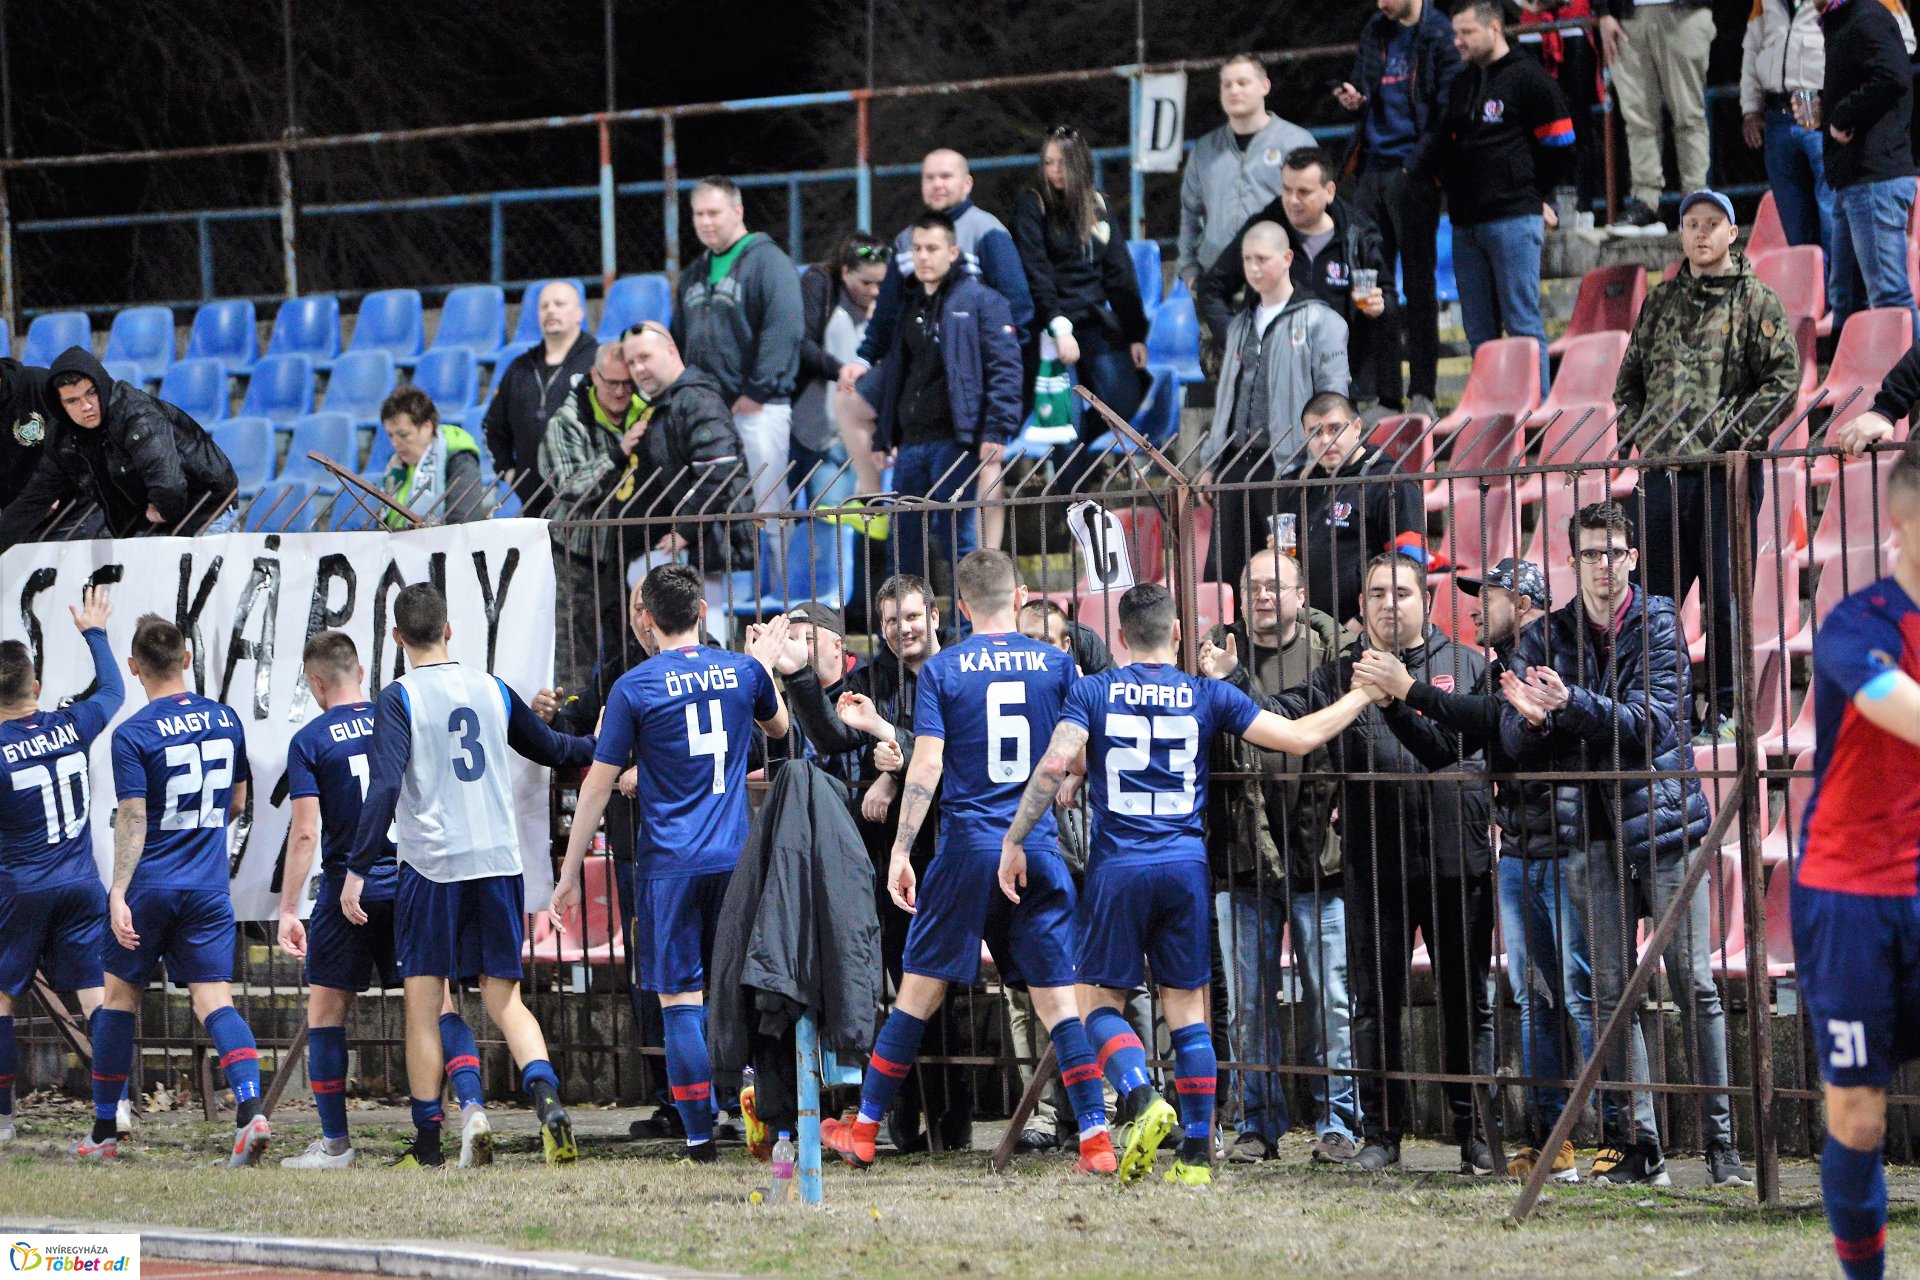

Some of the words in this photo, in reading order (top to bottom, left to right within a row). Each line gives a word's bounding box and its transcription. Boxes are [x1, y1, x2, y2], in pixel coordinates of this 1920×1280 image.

[1150, 97, 1177, 151] D
[1083, 504, 1119, 585] C
[665, 664, 739, 697] ÖTVÖS
[959, 647, 1049, 673] KÁRTIK
[156, 711, 212, 737] NAGY
[218, 709, 234, 728] J.
[1109, 682, 1193, 708] FORRÓ
[2, 722, 80, 764] GYURJÁN
[448, 706, 486, 782] 3
[686, 699, 729, 794] 4
[986, 681, 1031, 784] 6
[1105, 713, 1200, 816] 23
[10, 751, 91, 844] 70
[160, 738, 235, 831] 22
[1828, 1019, 1868, 1068] 31
